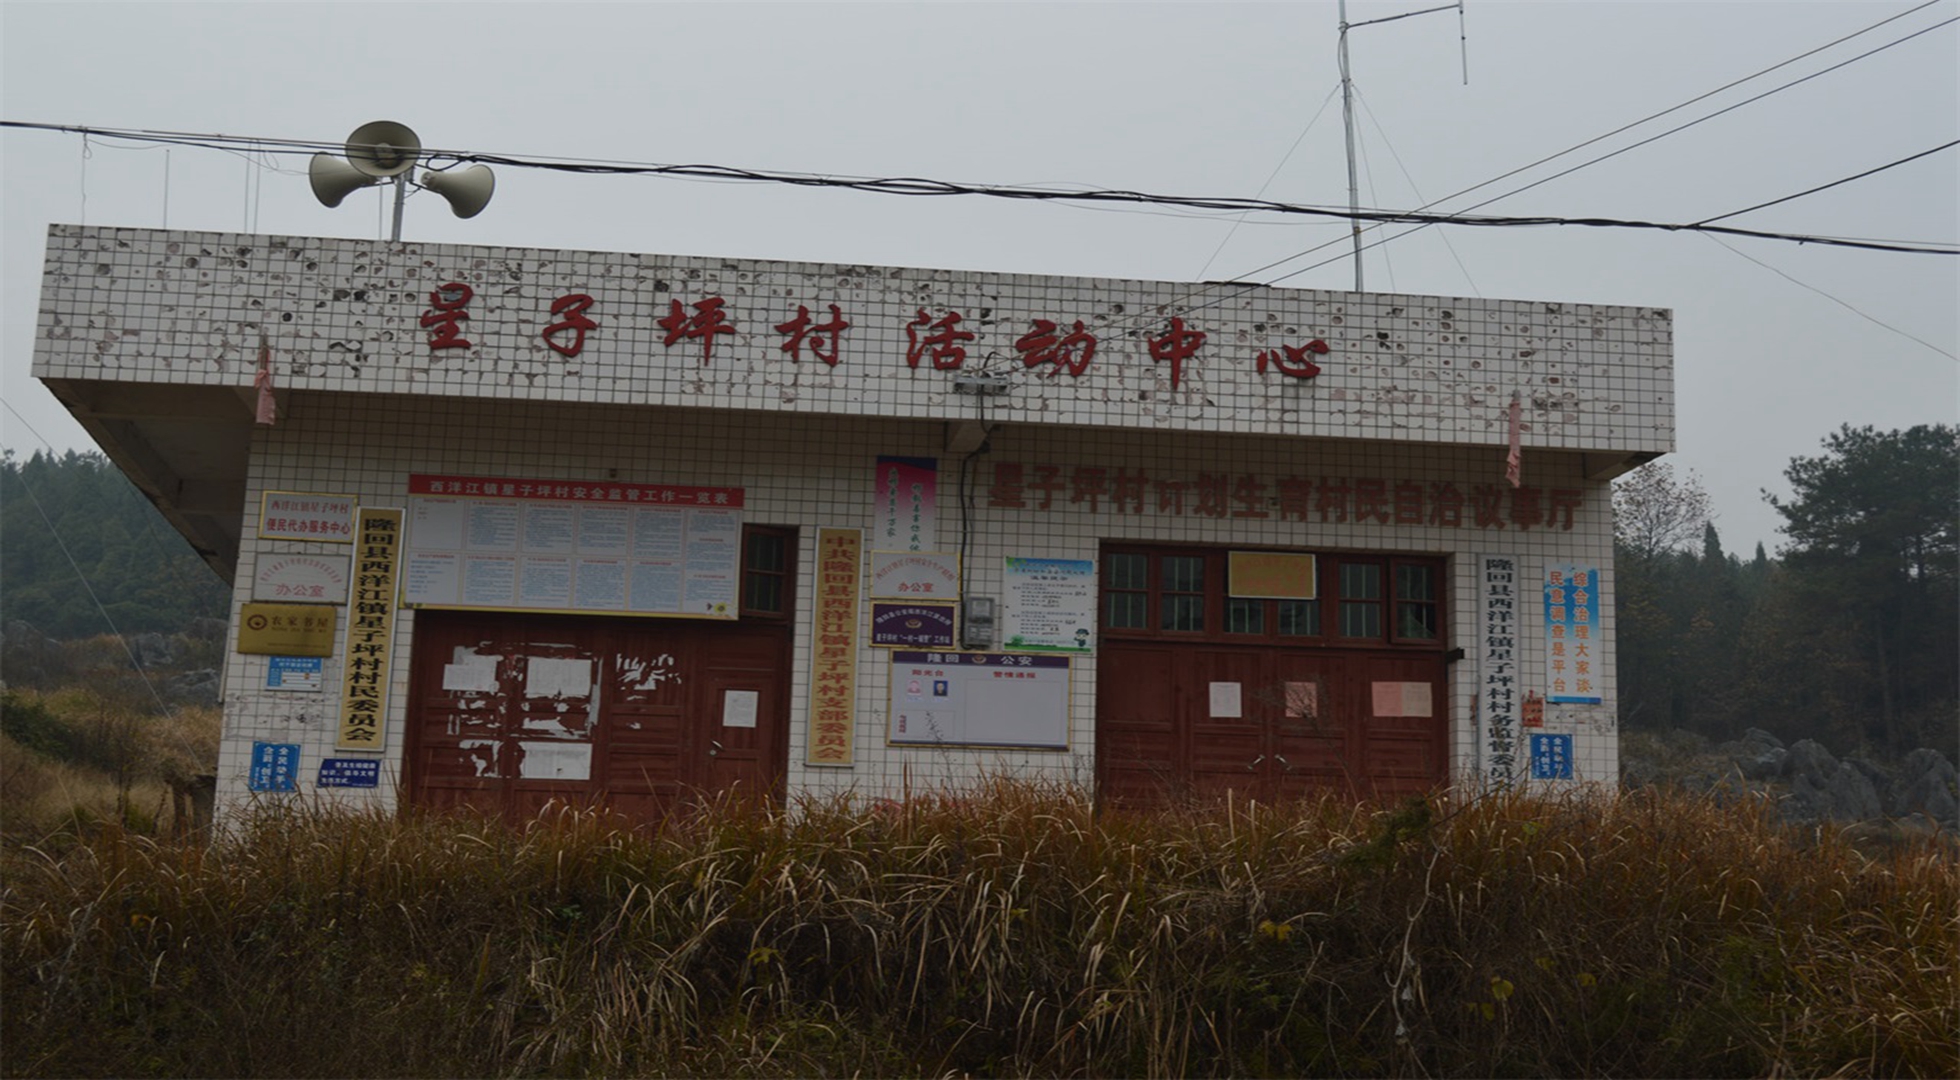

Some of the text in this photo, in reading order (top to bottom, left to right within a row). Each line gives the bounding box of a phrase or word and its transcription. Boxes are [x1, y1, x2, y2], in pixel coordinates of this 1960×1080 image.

[419, 283, 1330, 391] 星子坪村活动中心
[429, 480, 730, 506] 西洋江镇星子坪村安全监管工作一览表
[987, 461, 1582, 532] 星子坪村计划生育村民自治议事厅
[271, 499, 349, 514] 西洋江镇星子坪村
[267, 517, 351, 535] 便民代办服务中心
[276, 582, 325, 597] 办公室
[898, 581, 934, 593] 办公室
[271, 615, 329, 629] 农家书屋
[344, 518, 396, 741] 隆回县西洋江镇星子坪村村民委员会
[1549, 571, 1567, 693] 民意调查是平台
[1573, 571, 1592, 693] 综合治理大家谈
[816, 535, 859, 760] 中共隆回县西洋江镇星子坪村支部委员会
[927, 653, 1034, 666] 隆回 公安
